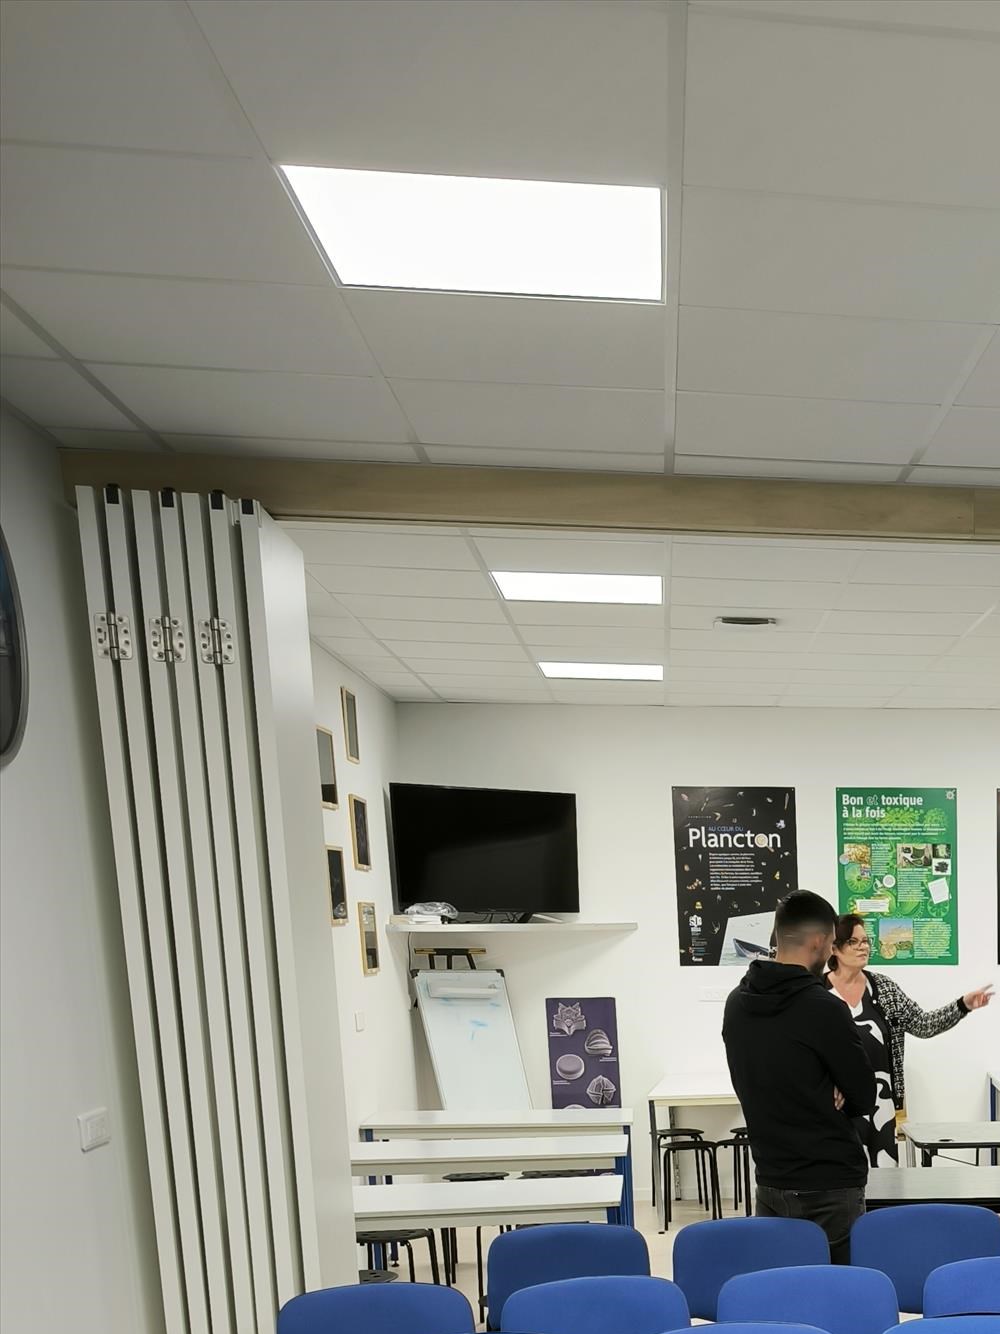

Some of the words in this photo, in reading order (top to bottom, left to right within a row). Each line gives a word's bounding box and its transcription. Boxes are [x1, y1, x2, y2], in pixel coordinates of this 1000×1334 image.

[842, 795, 863, 805] Bon
[881, 795, 923, 807] toxique
[842, 807, 849, 818] à
[852, 807, 862, 818] la
[866, 807, 886, 818] fois
[688, 826, 781, 848] Plancton
